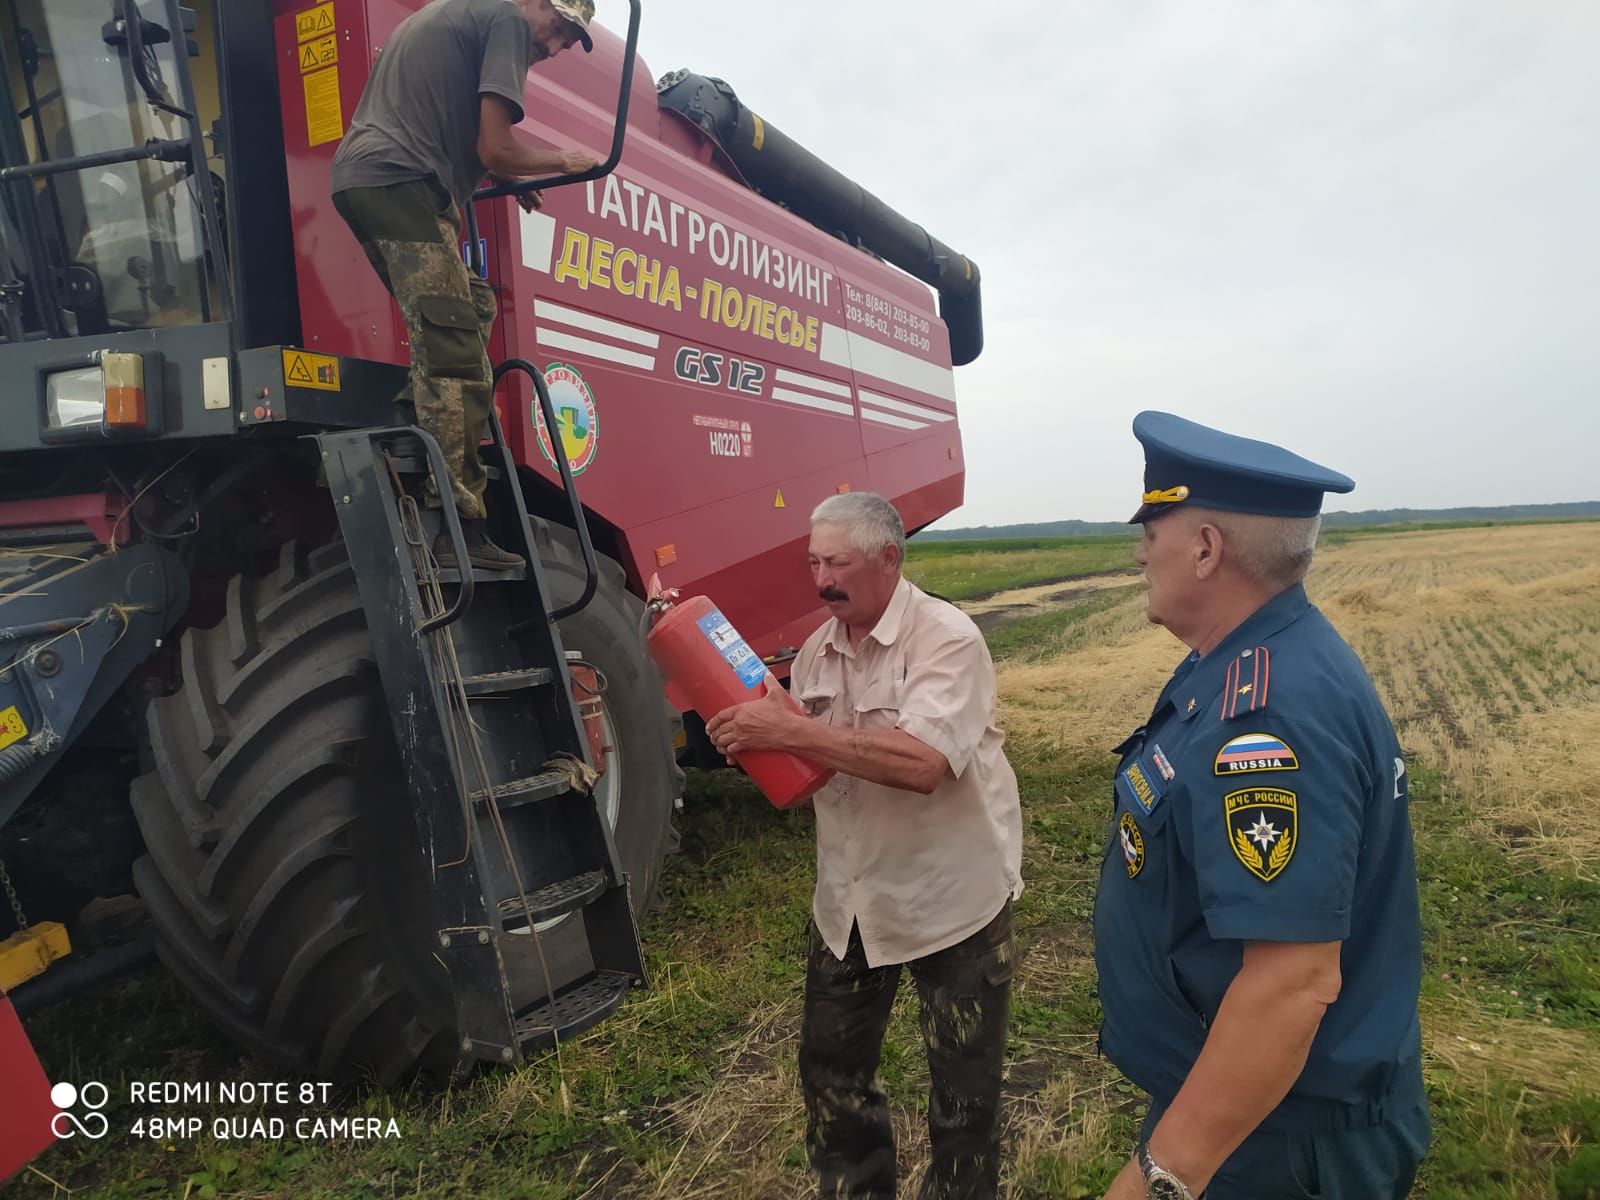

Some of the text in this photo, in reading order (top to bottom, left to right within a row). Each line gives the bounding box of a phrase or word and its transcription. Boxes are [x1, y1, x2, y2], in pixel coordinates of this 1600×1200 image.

[893, 306, 930, 334] 203-85-00
[674, 346, 766, 396] GS 12
[1229, 758, 1283, 771] RUSSIA
[1228, 791, 1294, 809] МЧС РОССИИ
